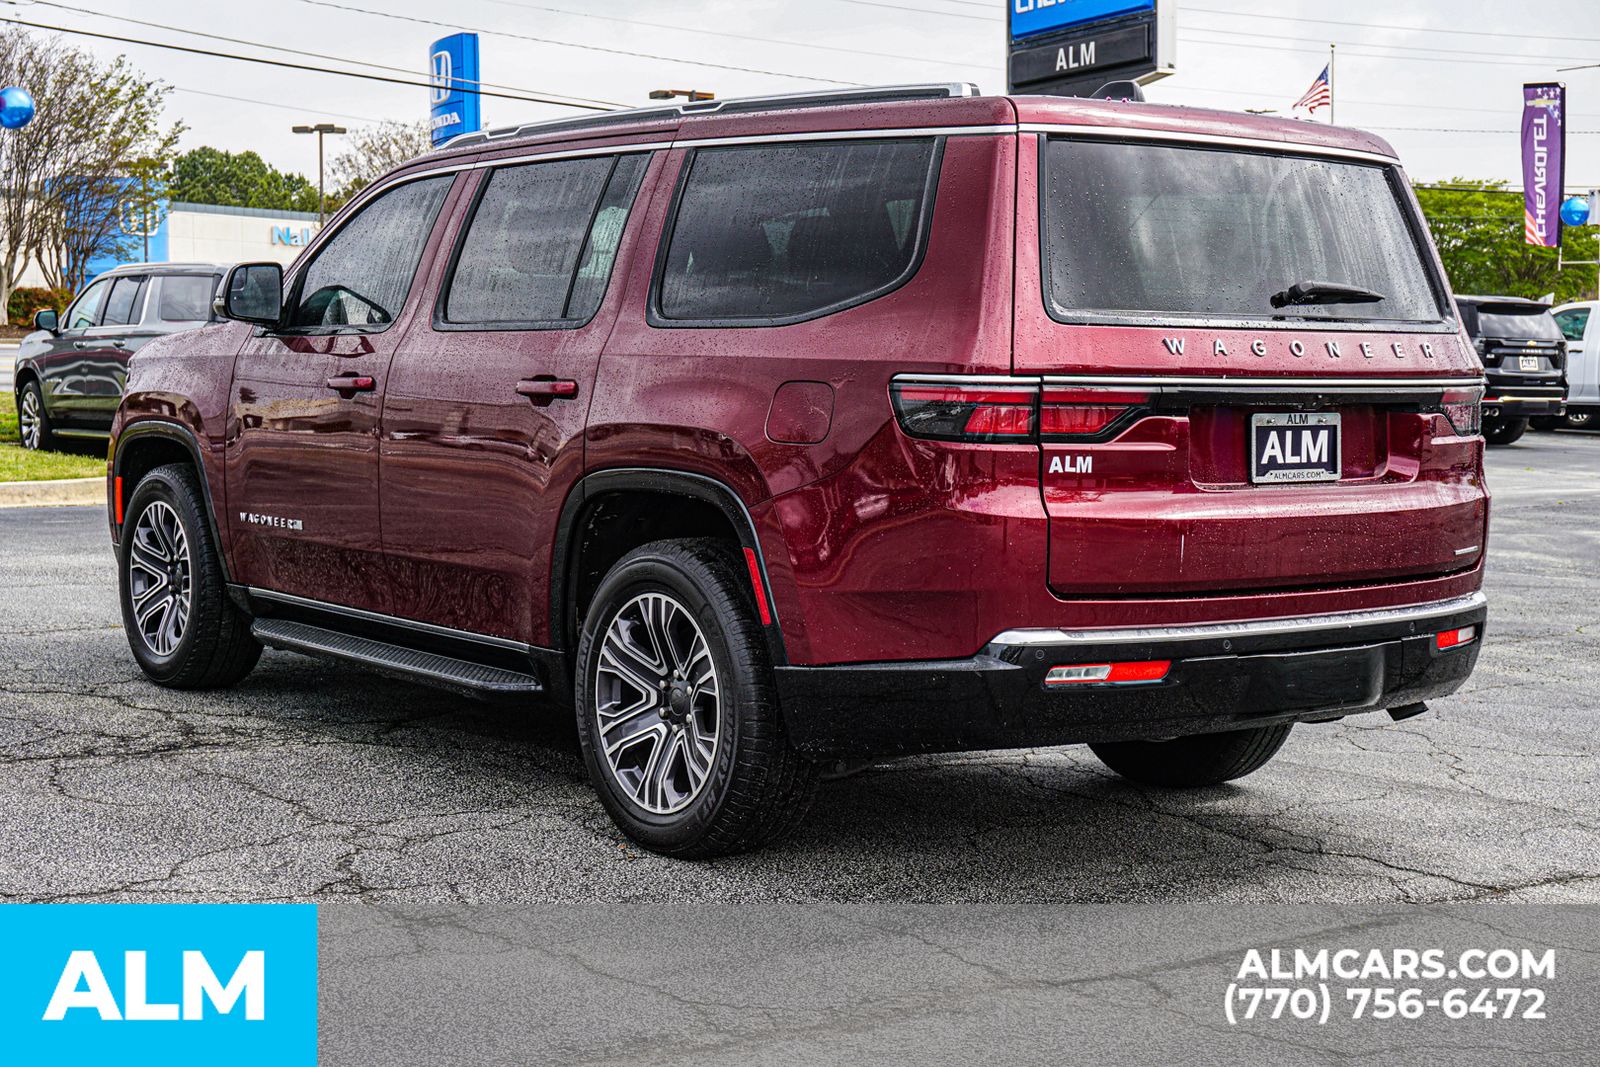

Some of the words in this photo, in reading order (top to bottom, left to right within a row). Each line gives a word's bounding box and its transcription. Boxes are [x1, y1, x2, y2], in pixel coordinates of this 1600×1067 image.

[1055, 41, 1096, 71] ALM
[1162, 336, 1435, 359] WAGONEER
[1286, 413, 1309, 425] ALM
[1260, 429, 1329, 465] ALM
[1048, 455, 1093, 474] ALM
[239, 511, 296, 530] WAGONEER
